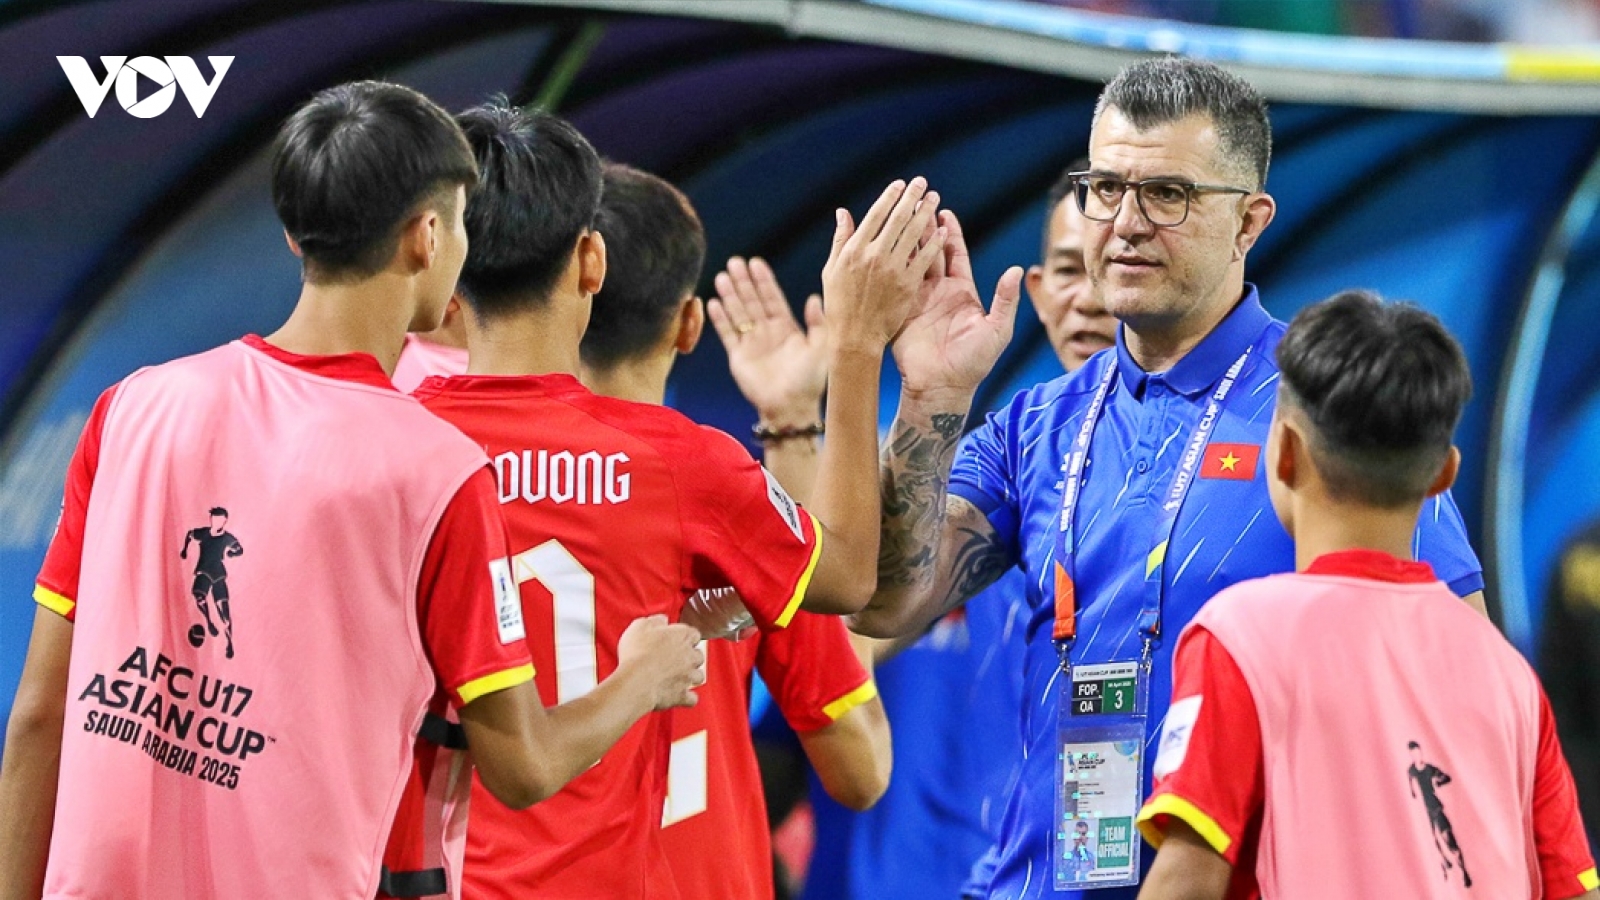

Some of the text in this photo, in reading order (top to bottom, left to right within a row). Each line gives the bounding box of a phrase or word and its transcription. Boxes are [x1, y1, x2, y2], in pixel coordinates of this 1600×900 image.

[1187, 431, 1207, 471] ASIAN
[1200, 403, 1219, 430] CUP
[117, 646, 253, 718] AFC U17
[1114, 690, 1123, 709] 3
[78, 673, 195, 740] ASIAN
[197, 717, 265, 760] CUP
[1079, 700, 1094, 713] OA
[84, 710, 241, 790] SAUDI ARABIA 2025
[1098, 842, 1129, 858] OFFICIAL
[1104, 826, 1126, 842] TEAM
